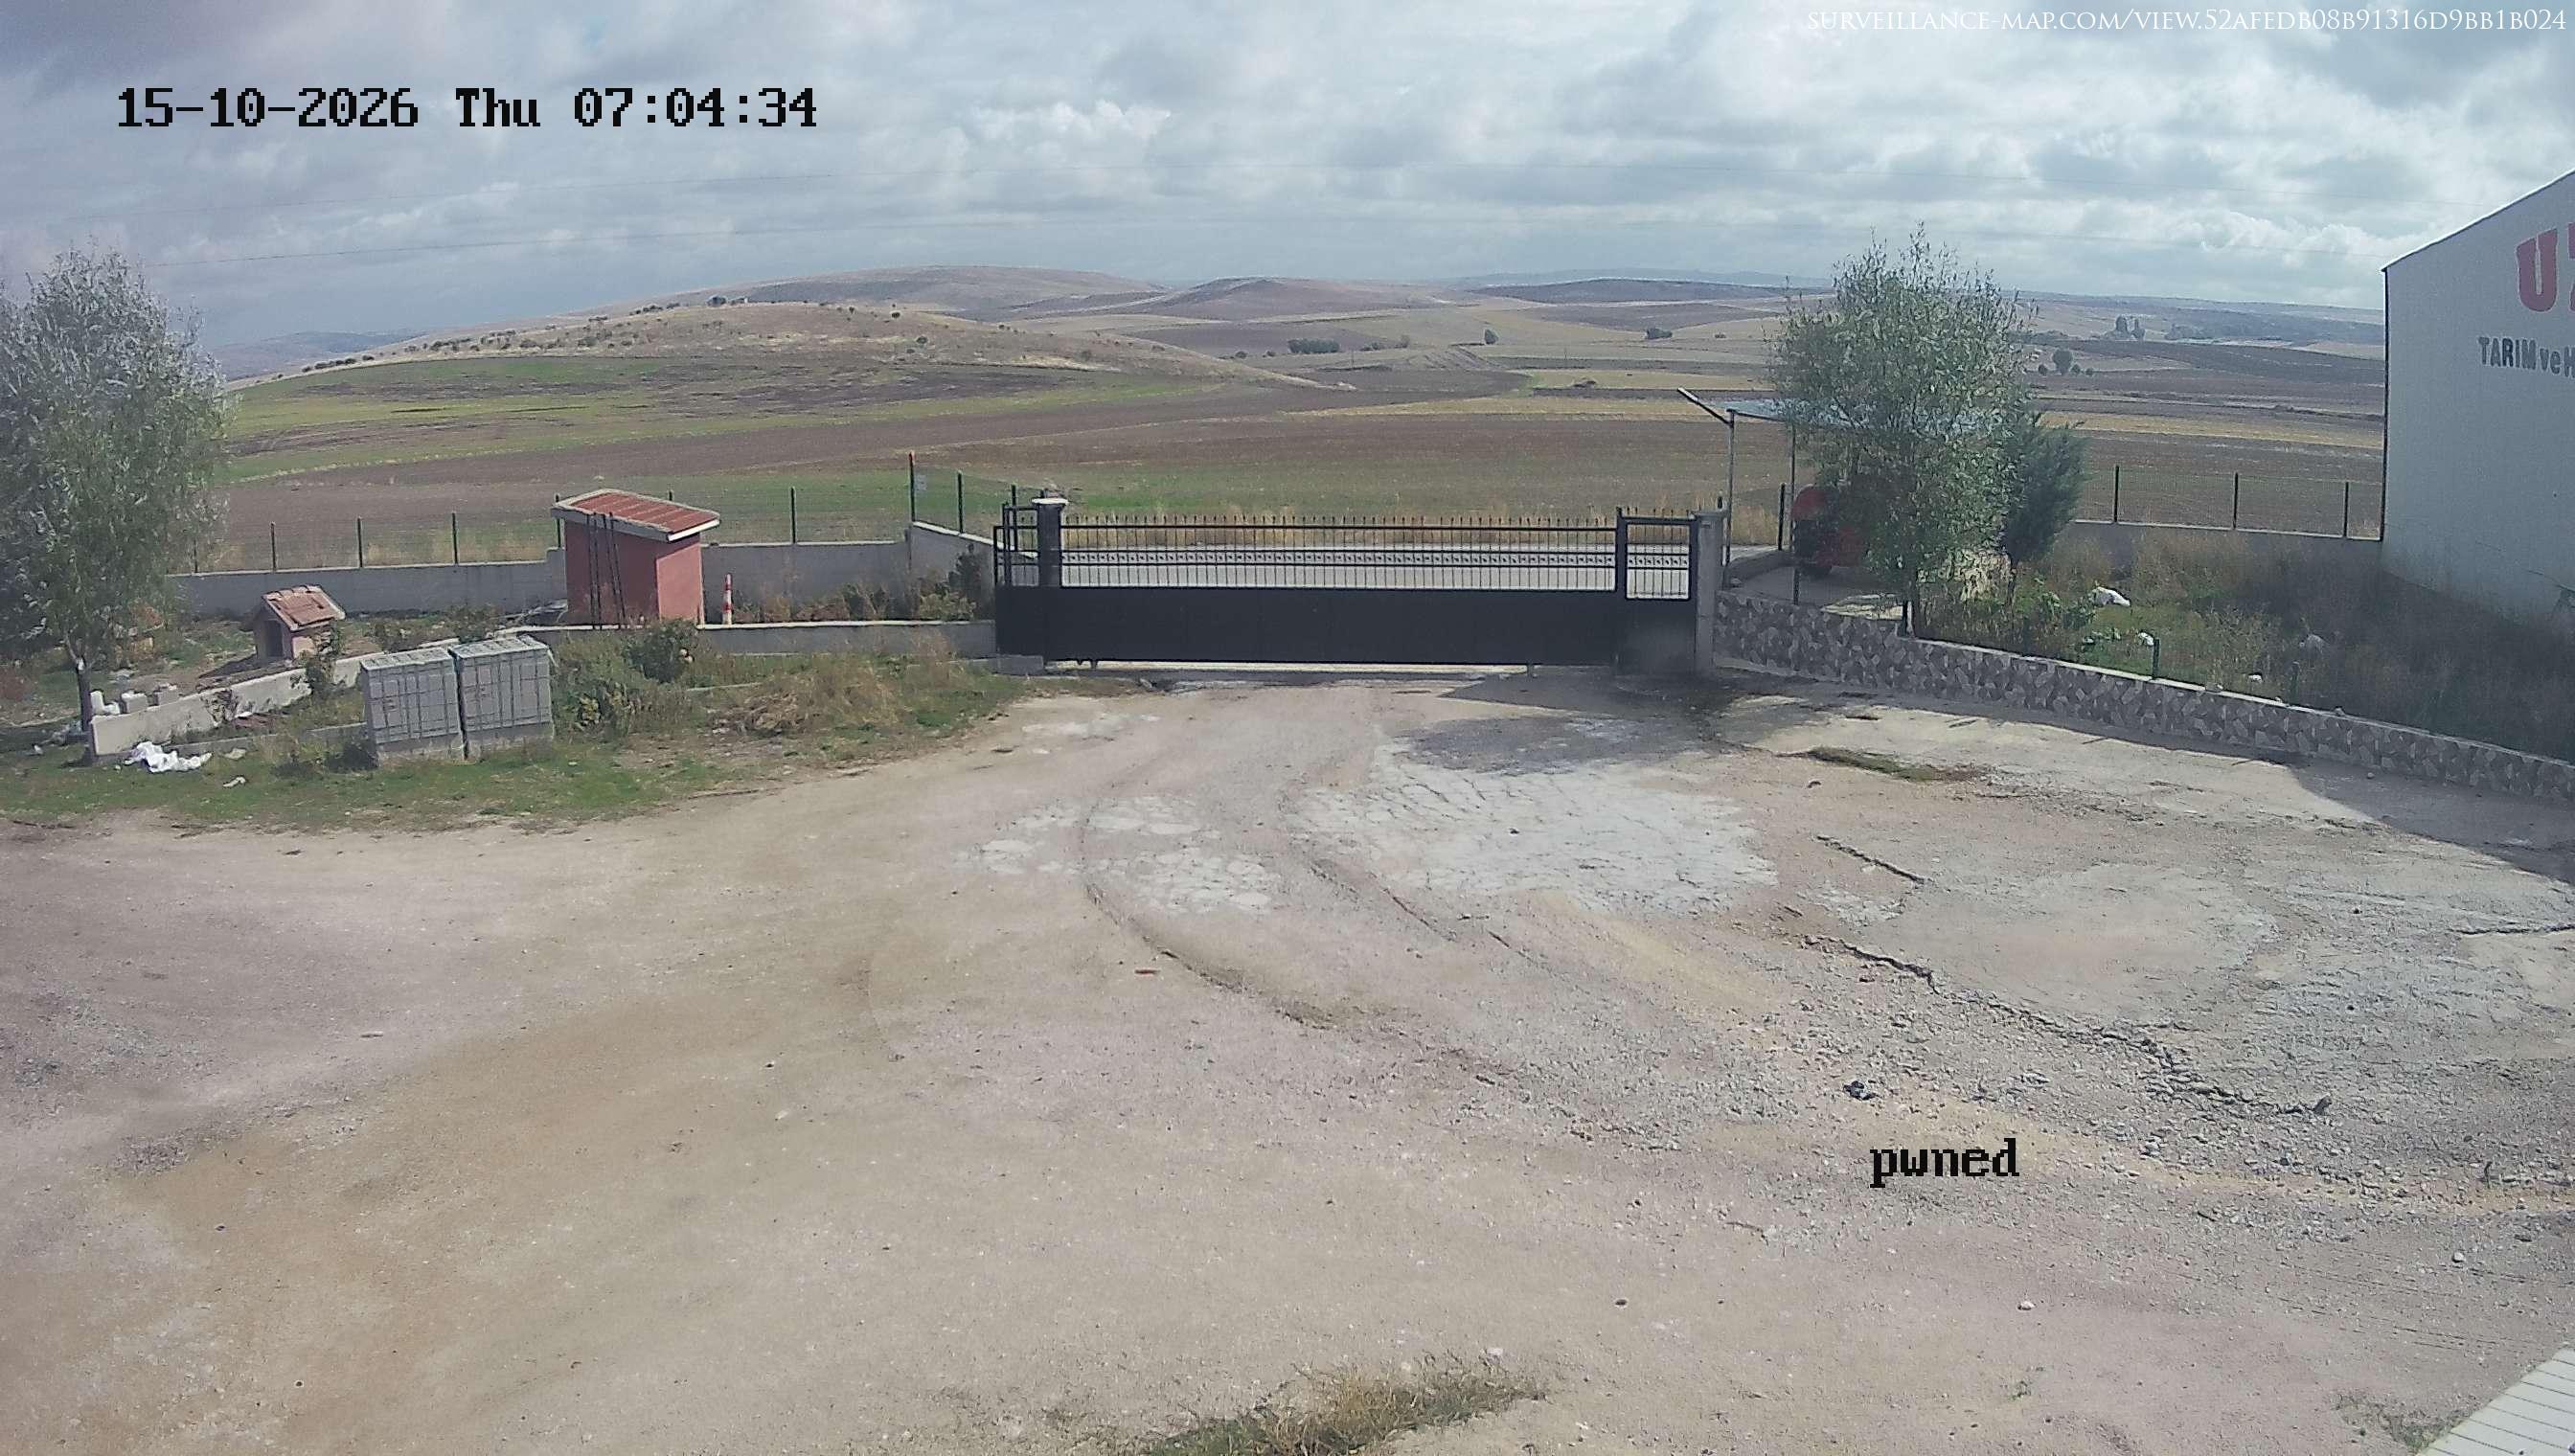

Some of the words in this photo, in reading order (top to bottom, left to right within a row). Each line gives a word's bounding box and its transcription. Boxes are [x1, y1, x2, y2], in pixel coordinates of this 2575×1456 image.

[2516, 221, 2575, 312] U
[2478, 336, 2537, 371] TARIM
[2539, 348, 2562, 375] ve
